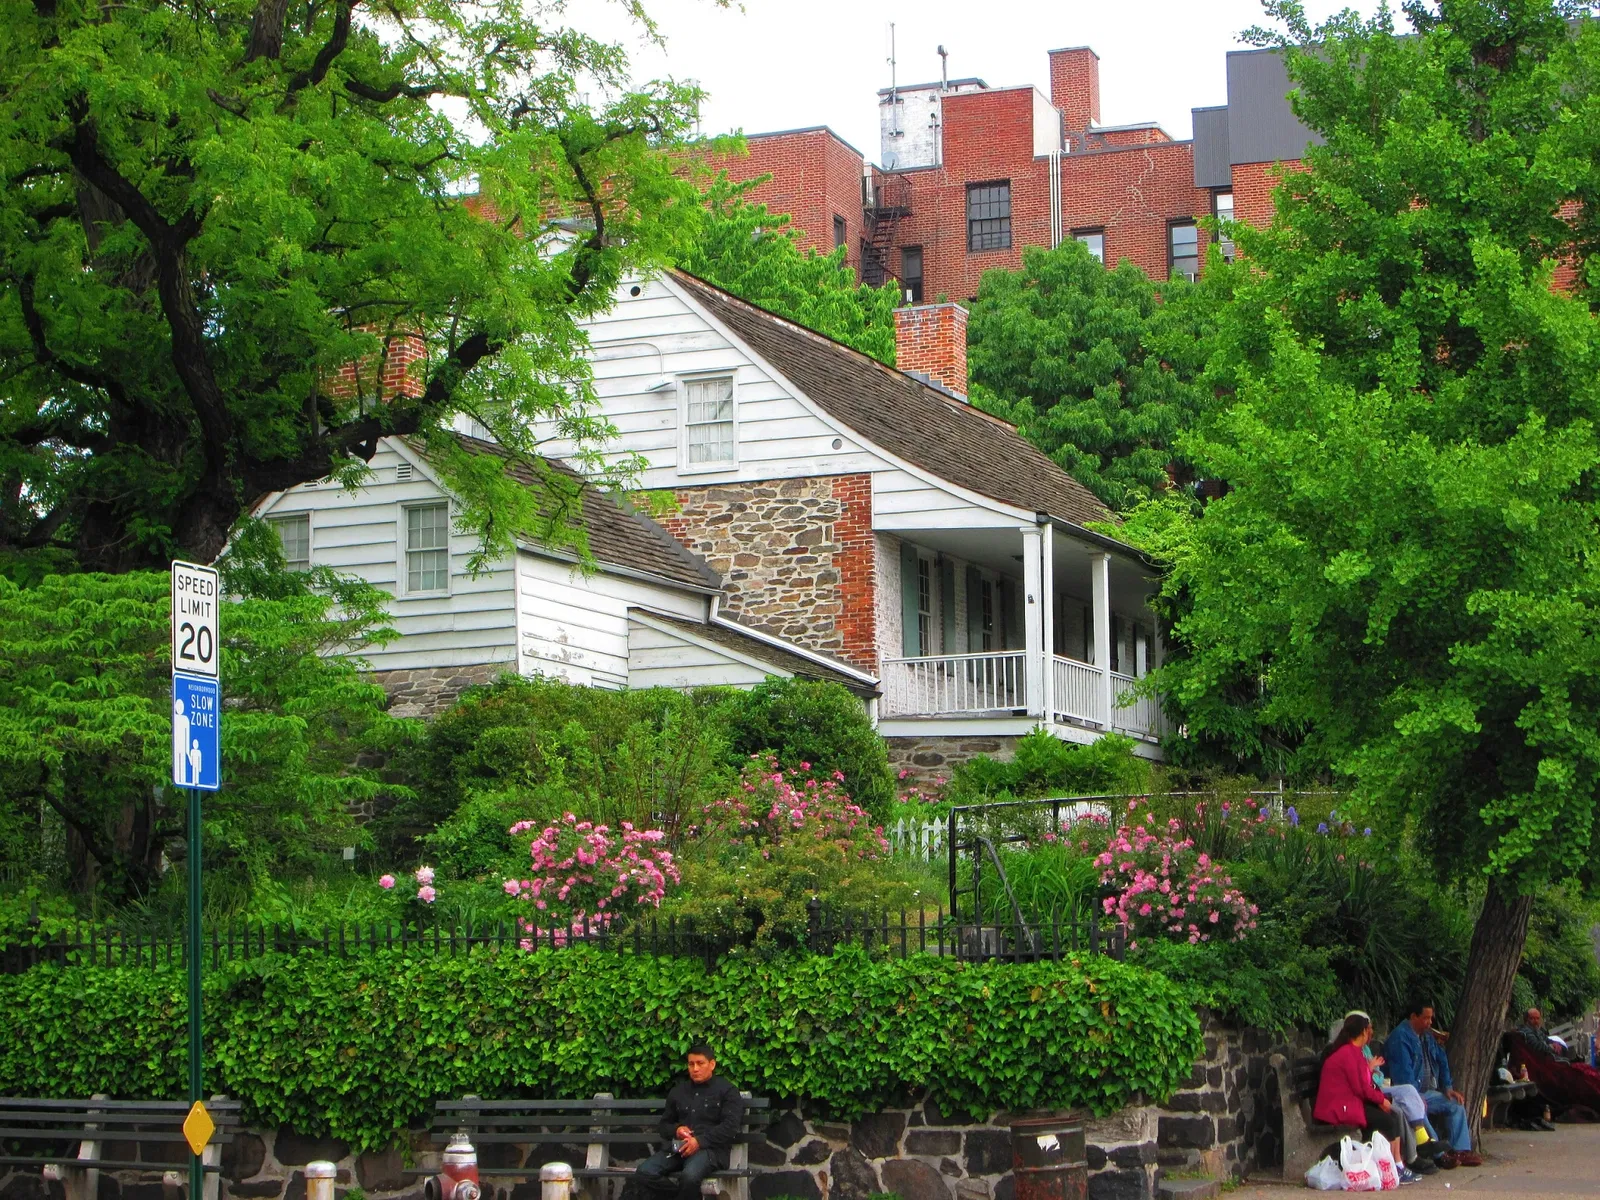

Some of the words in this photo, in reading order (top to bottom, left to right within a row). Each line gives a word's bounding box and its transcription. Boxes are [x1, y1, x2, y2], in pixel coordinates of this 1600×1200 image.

[178, 574, 213, 596] SPEED
[180, 597, 211, 618] LIMIT
[180, 622, 213, 663] 20
[191, 694, 213, 711] SLOW
[190, 711, 214, 728] ZONE
